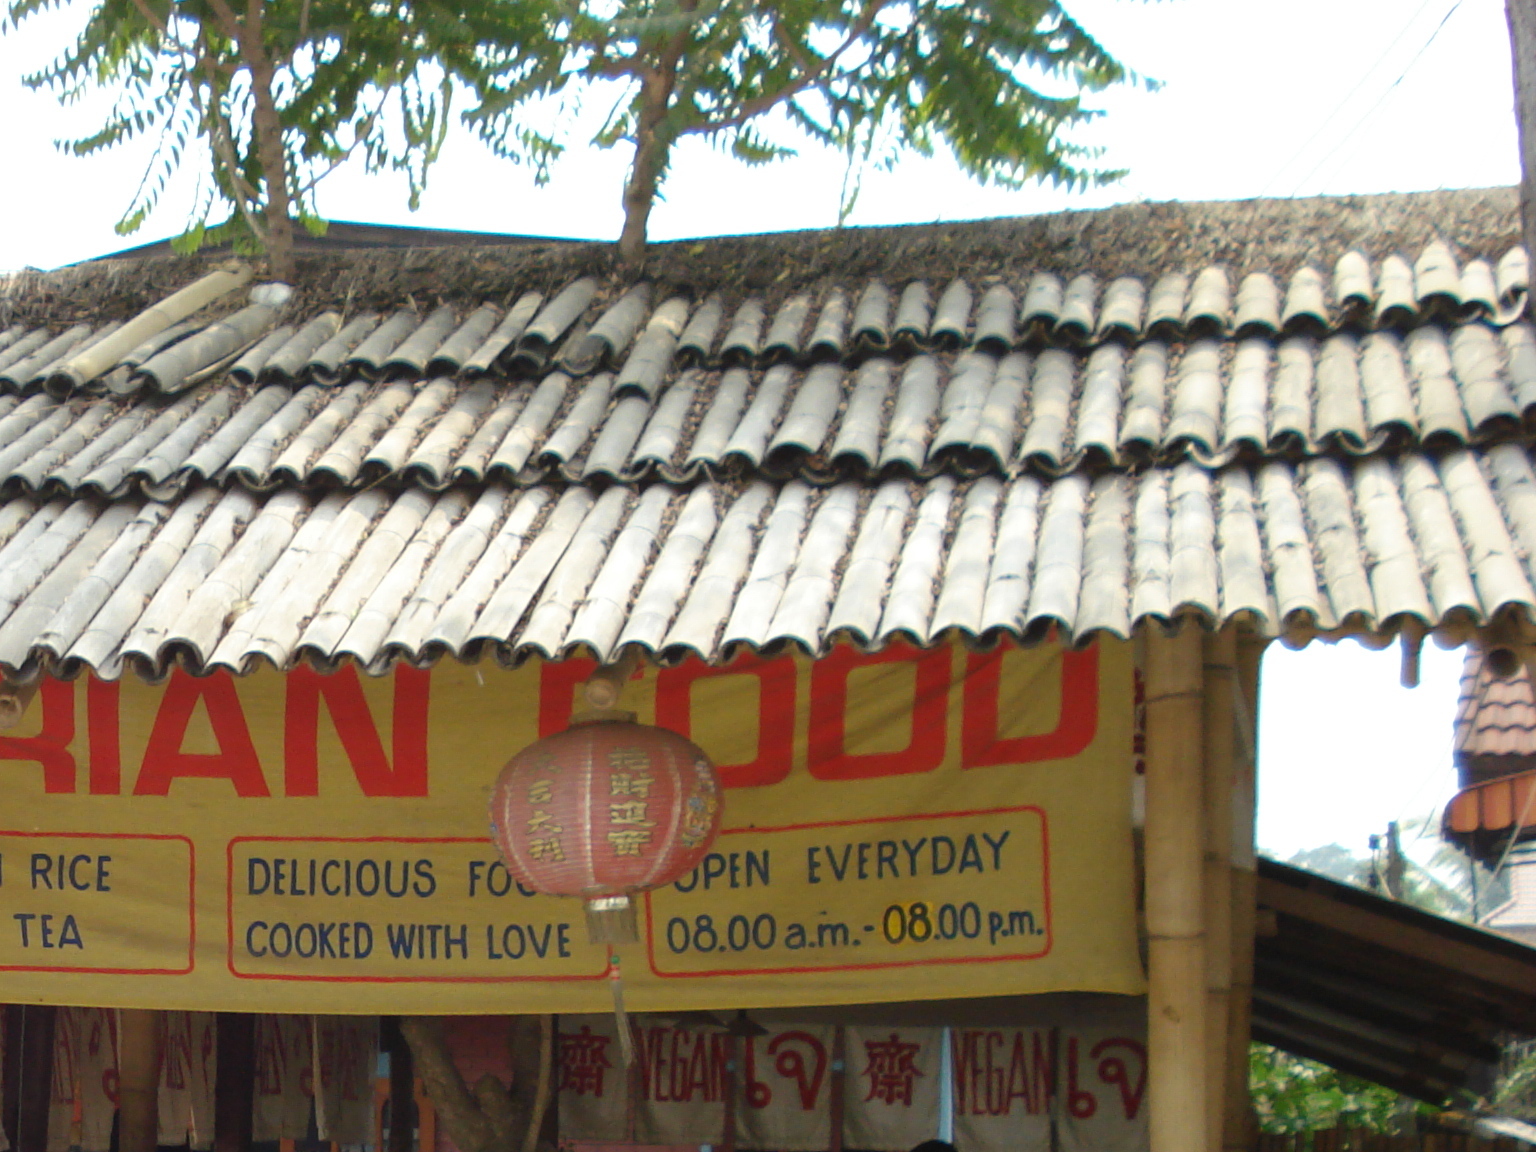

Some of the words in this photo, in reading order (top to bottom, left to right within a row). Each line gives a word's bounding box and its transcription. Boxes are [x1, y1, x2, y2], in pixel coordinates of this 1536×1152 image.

[31, 853, 113, 893] RICE
[248, 857, 437, 897] DELICIOUS
[469, 860, 535, 899] FOO
[673, 849, 771, 892] OPEN
[807, 831, 1010, 884] EVERYDAY
[14, 913, 85, 950] TEA
[246, 922, 373, 960] COOKED
[387, 923, 468, 961] WITH
[488, 923, 571, 960] LOVE
[667, 913, 777, 954] 08.00
[883, 902, 981, 945] 08.00
[989, 911, 1045, 945] p.m.
[743, 1031, 827, 1111] เจ
[952, 1030, 1054, 1115] VEGAN
[1067, 1036, 1149, 1120] เจ
